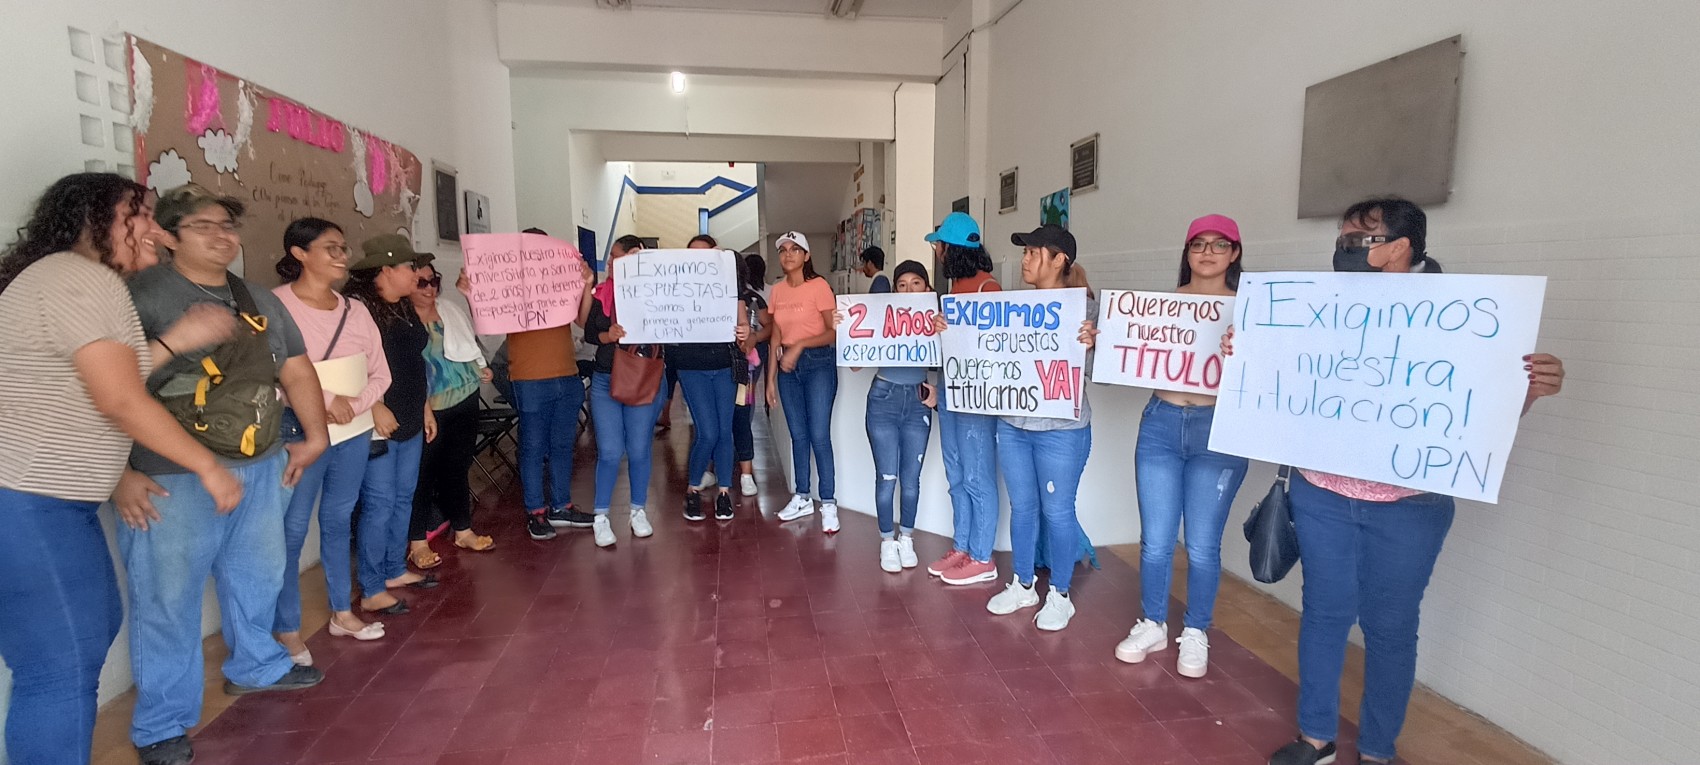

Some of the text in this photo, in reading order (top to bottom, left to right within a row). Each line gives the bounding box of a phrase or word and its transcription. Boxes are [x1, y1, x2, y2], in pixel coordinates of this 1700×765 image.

[520, 248, 555, 261] nuestro
[490, 288, 499, 300] 2
[502, 284, 524, 299] años
[525, 285, 532, 299] y
[536, 283, 549, 296] no
[644, 299, 702, 312] Somos la
[1106, 291, 1225, 323] ¡Queremos
[642, 317, 679, 332] primera
[654, 326, 684, 339] UPN
[848, 303, 936, 338] 2 Años
[1126, 321, 1197, 345] nuestro
[1242, 281, 1500, 360] ¡Exigimos
[842, 339, 939, 366] esperando!!
[977, 330, 1060, 353] respuestas
[946, 356, 1022, 380] Queremos
[1113, 342, 1224, 390] TÍTULO
[1297, 334, 1455, 393] nuestra
[1034, 359, 1082, 419] YA!
[1228, 361, 1473, 440] titulación!
[1391, 443, 1493, 492] UPN
